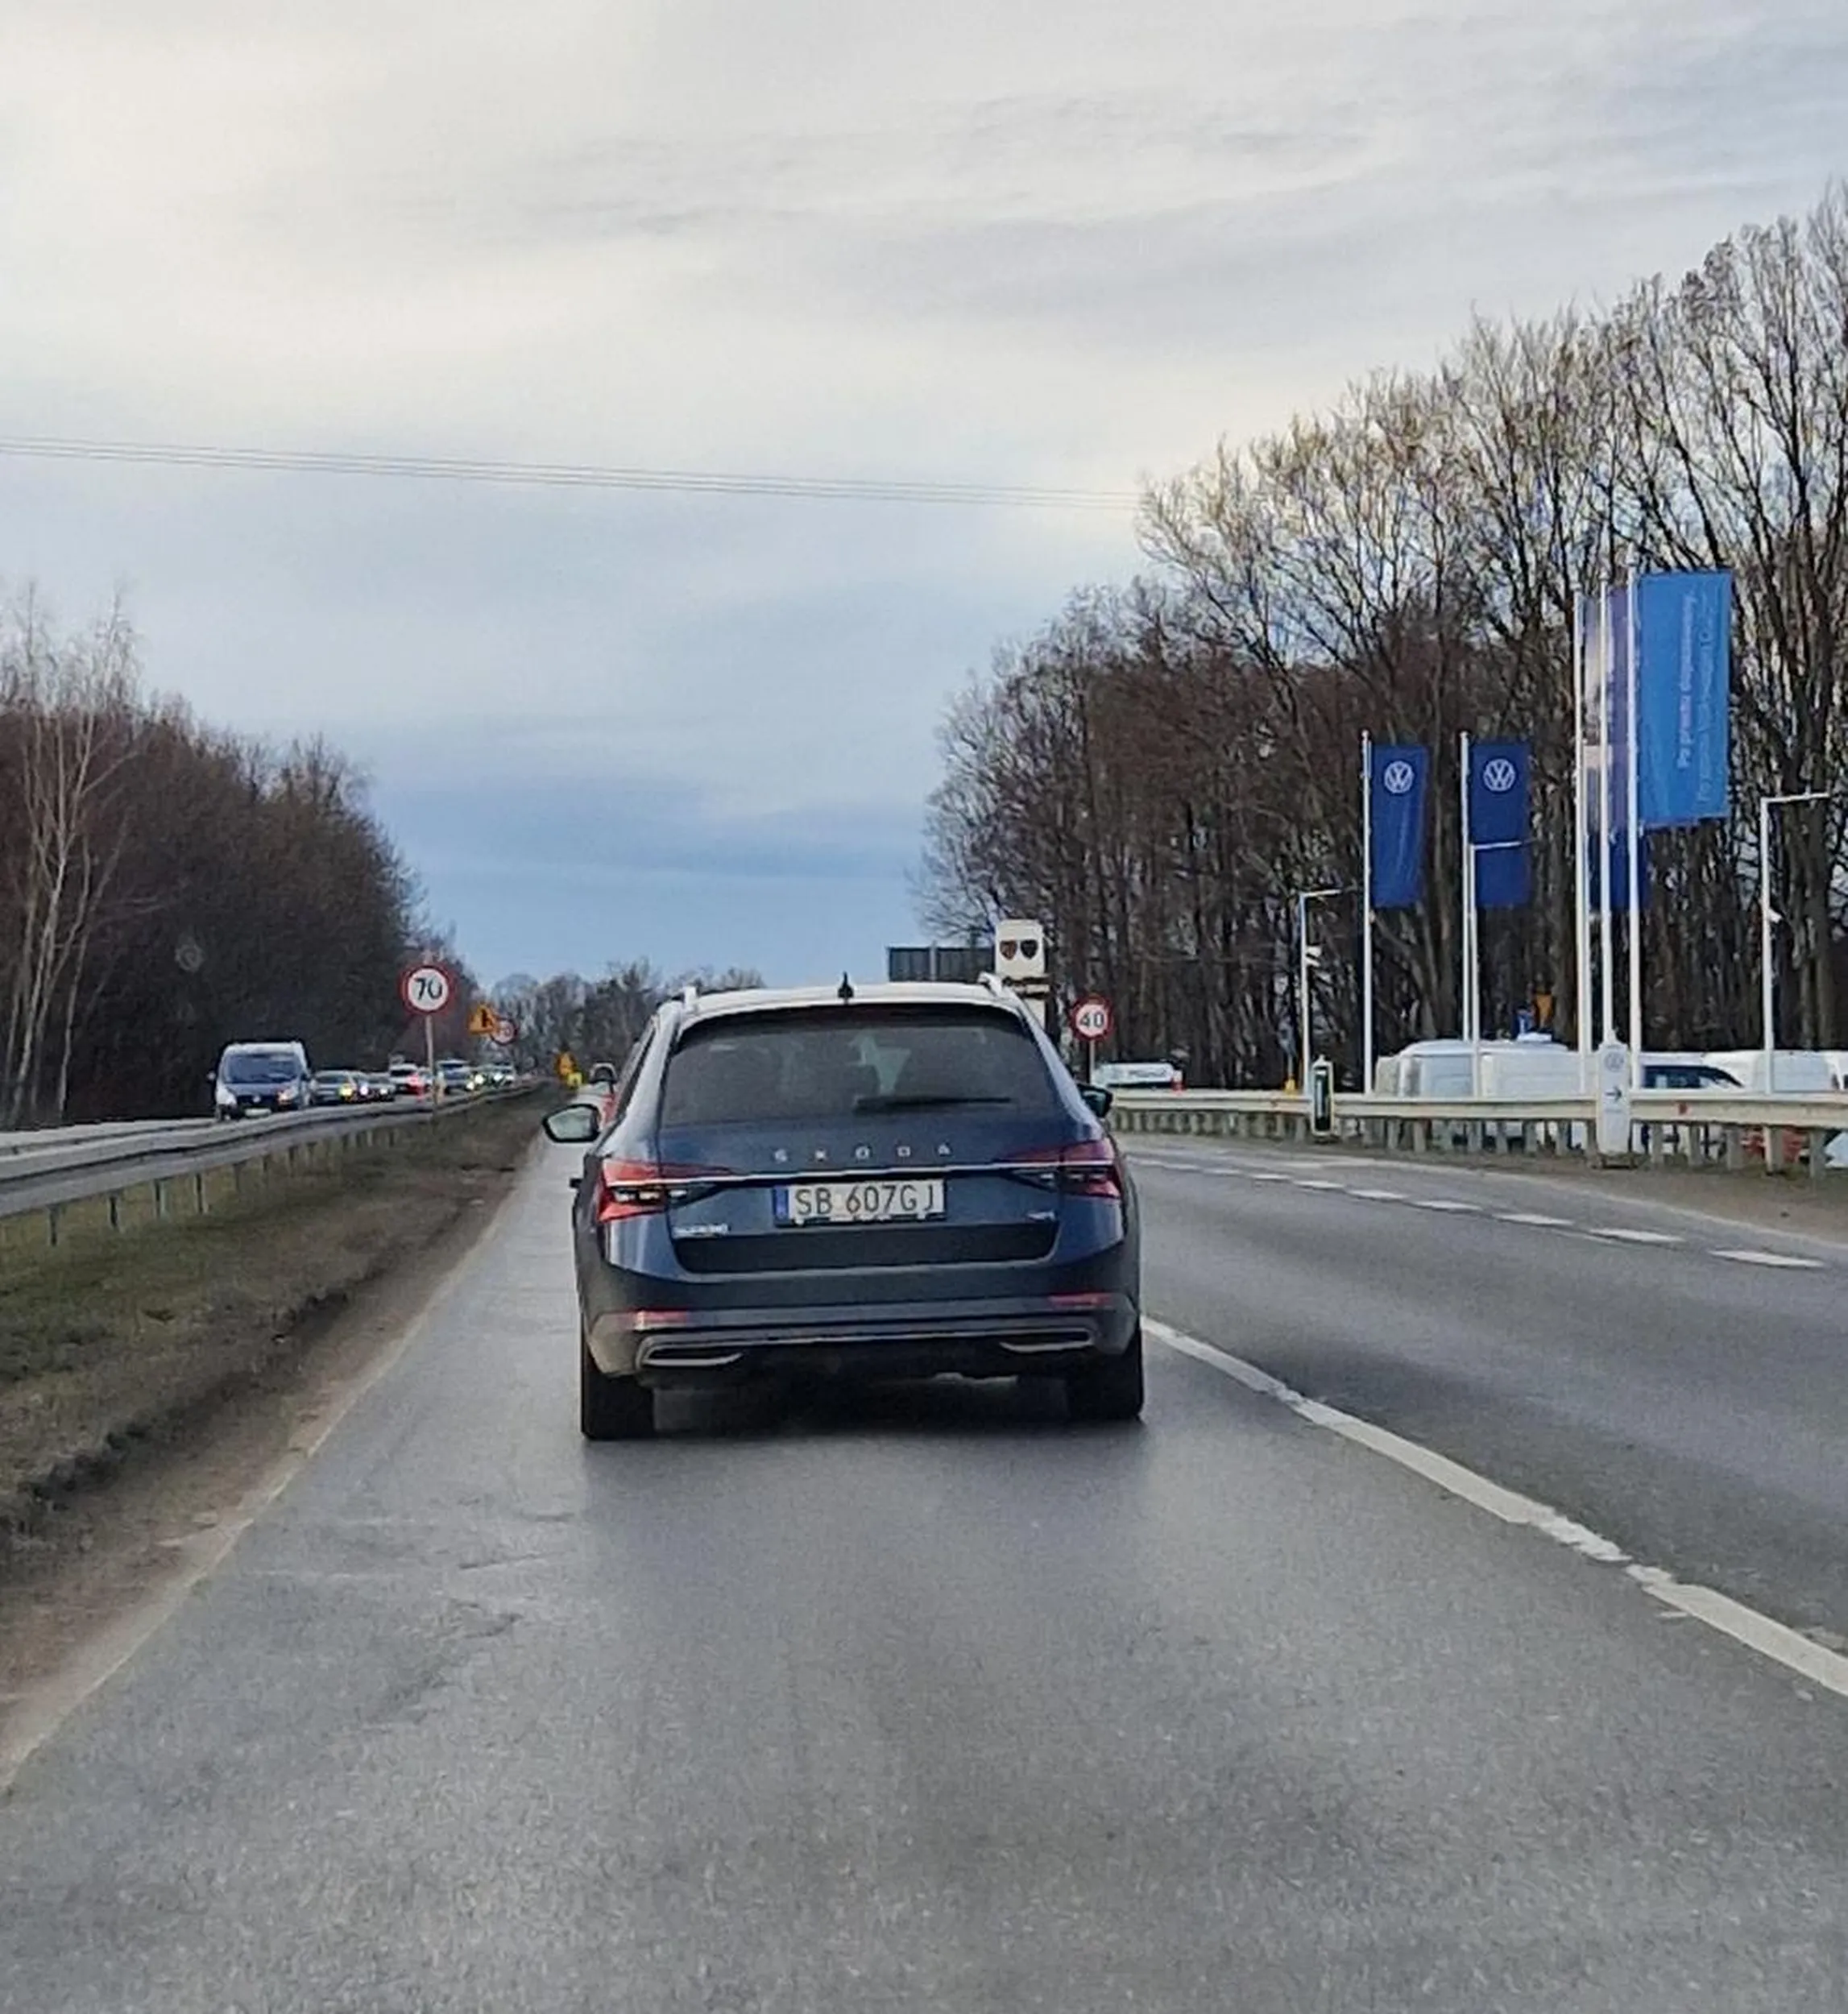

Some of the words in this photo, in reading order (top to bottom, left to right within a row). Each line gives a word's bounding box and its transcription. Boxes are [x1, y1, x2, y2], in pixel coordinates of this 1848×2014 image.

[414, 976, 443, 1001] 70
[1079, 1010, 1104, 1029] 40
[795, 1187, 833, 1216] SB
[846, 1183, 934, 1215] 607GJ
